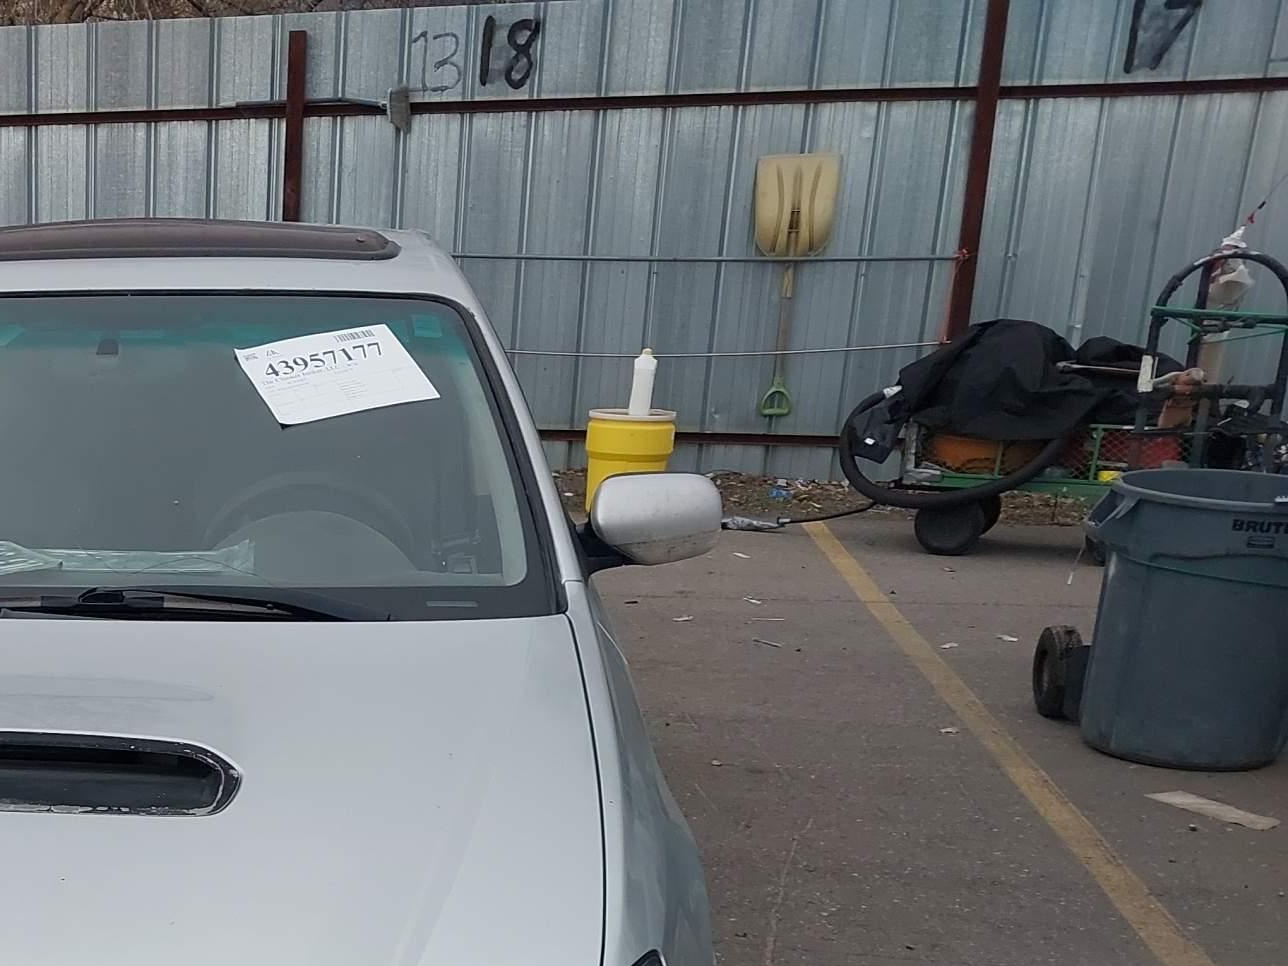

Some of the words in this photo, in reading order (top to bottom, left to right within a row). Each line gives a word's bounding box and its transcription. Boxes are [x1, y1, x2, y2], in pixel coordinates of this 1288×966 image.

[409, 30, 462, 92] 13
[480, 15, 541, 90] 18
[264, 341, 382, 378] 43957177
